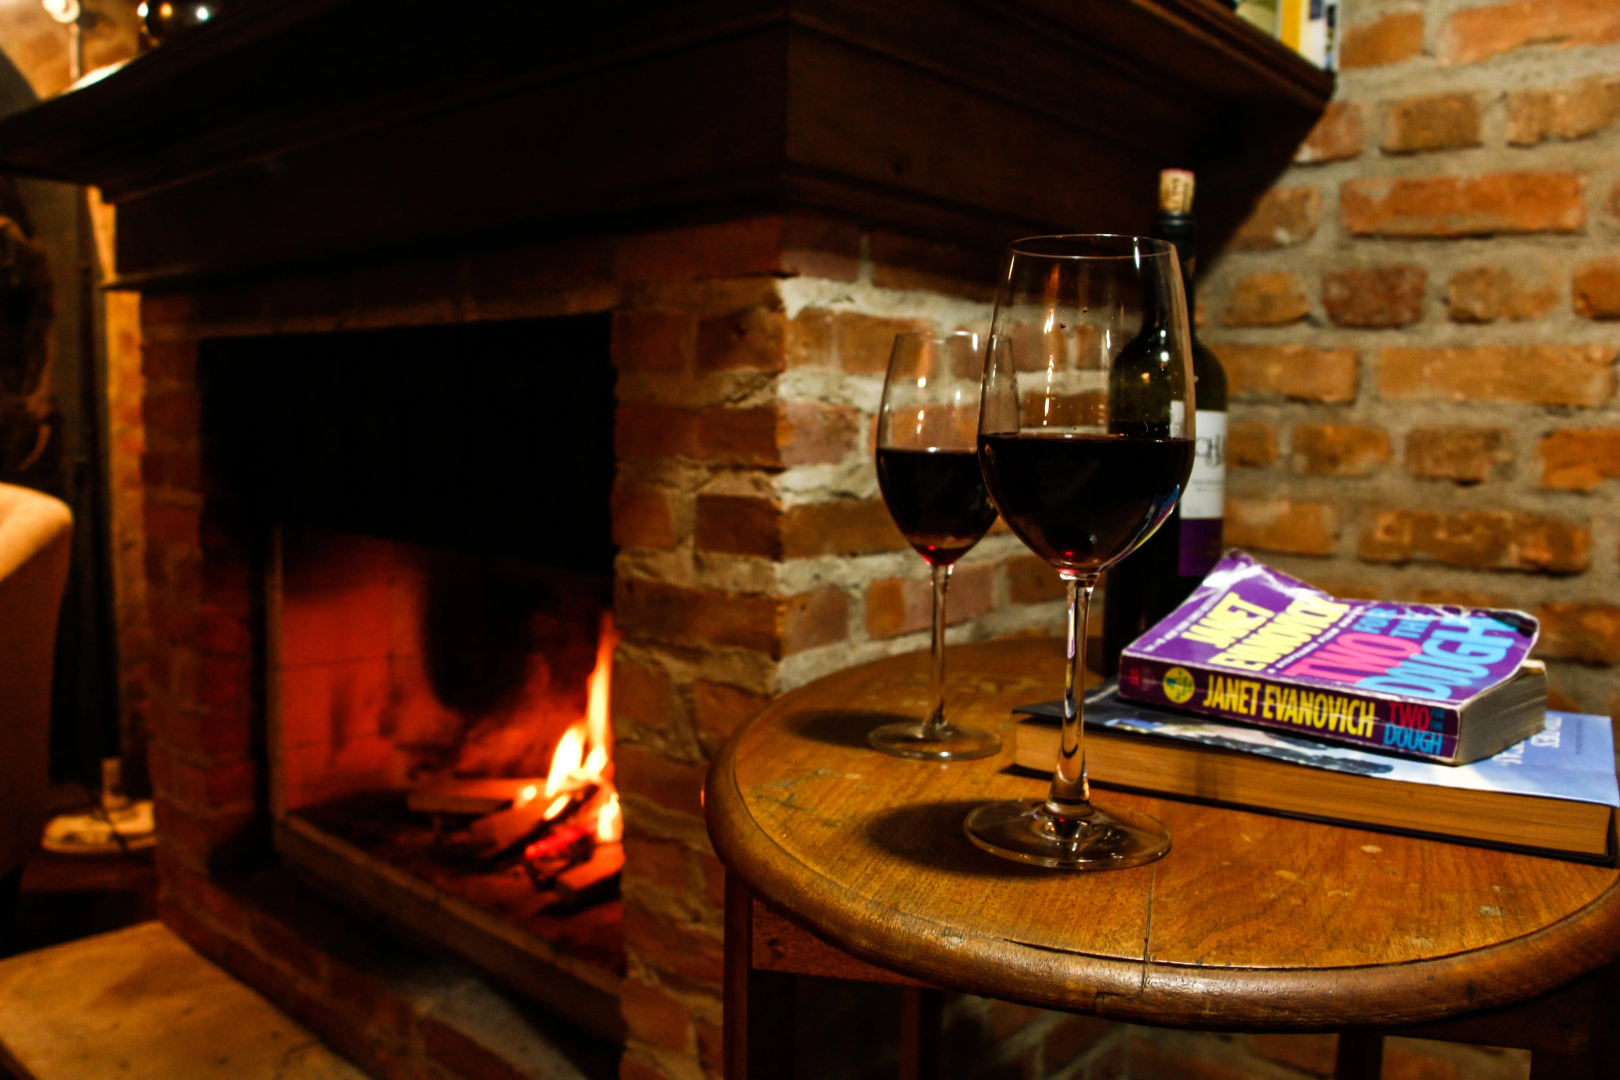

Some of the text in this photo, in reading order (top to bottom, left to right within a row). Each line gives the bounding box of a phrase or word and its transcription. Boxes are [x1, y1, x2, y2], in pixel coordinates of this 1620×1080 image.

[1181, 592, 1275, 649] JANET
[1352, 608, 1397, 634] FOR
[1389, 612, 1434, 639] THE
[1282, 632, 1422, 684] TWO
[1355, 611, 1517, 700] DOUGH
[1203, 675, 1260, 716] JANET
[1262, 684, 1375, 738] EVANOVICH
[1389, 701, 1430, 731] TWO
[1383, 722, 1443, 755] DOUGH
